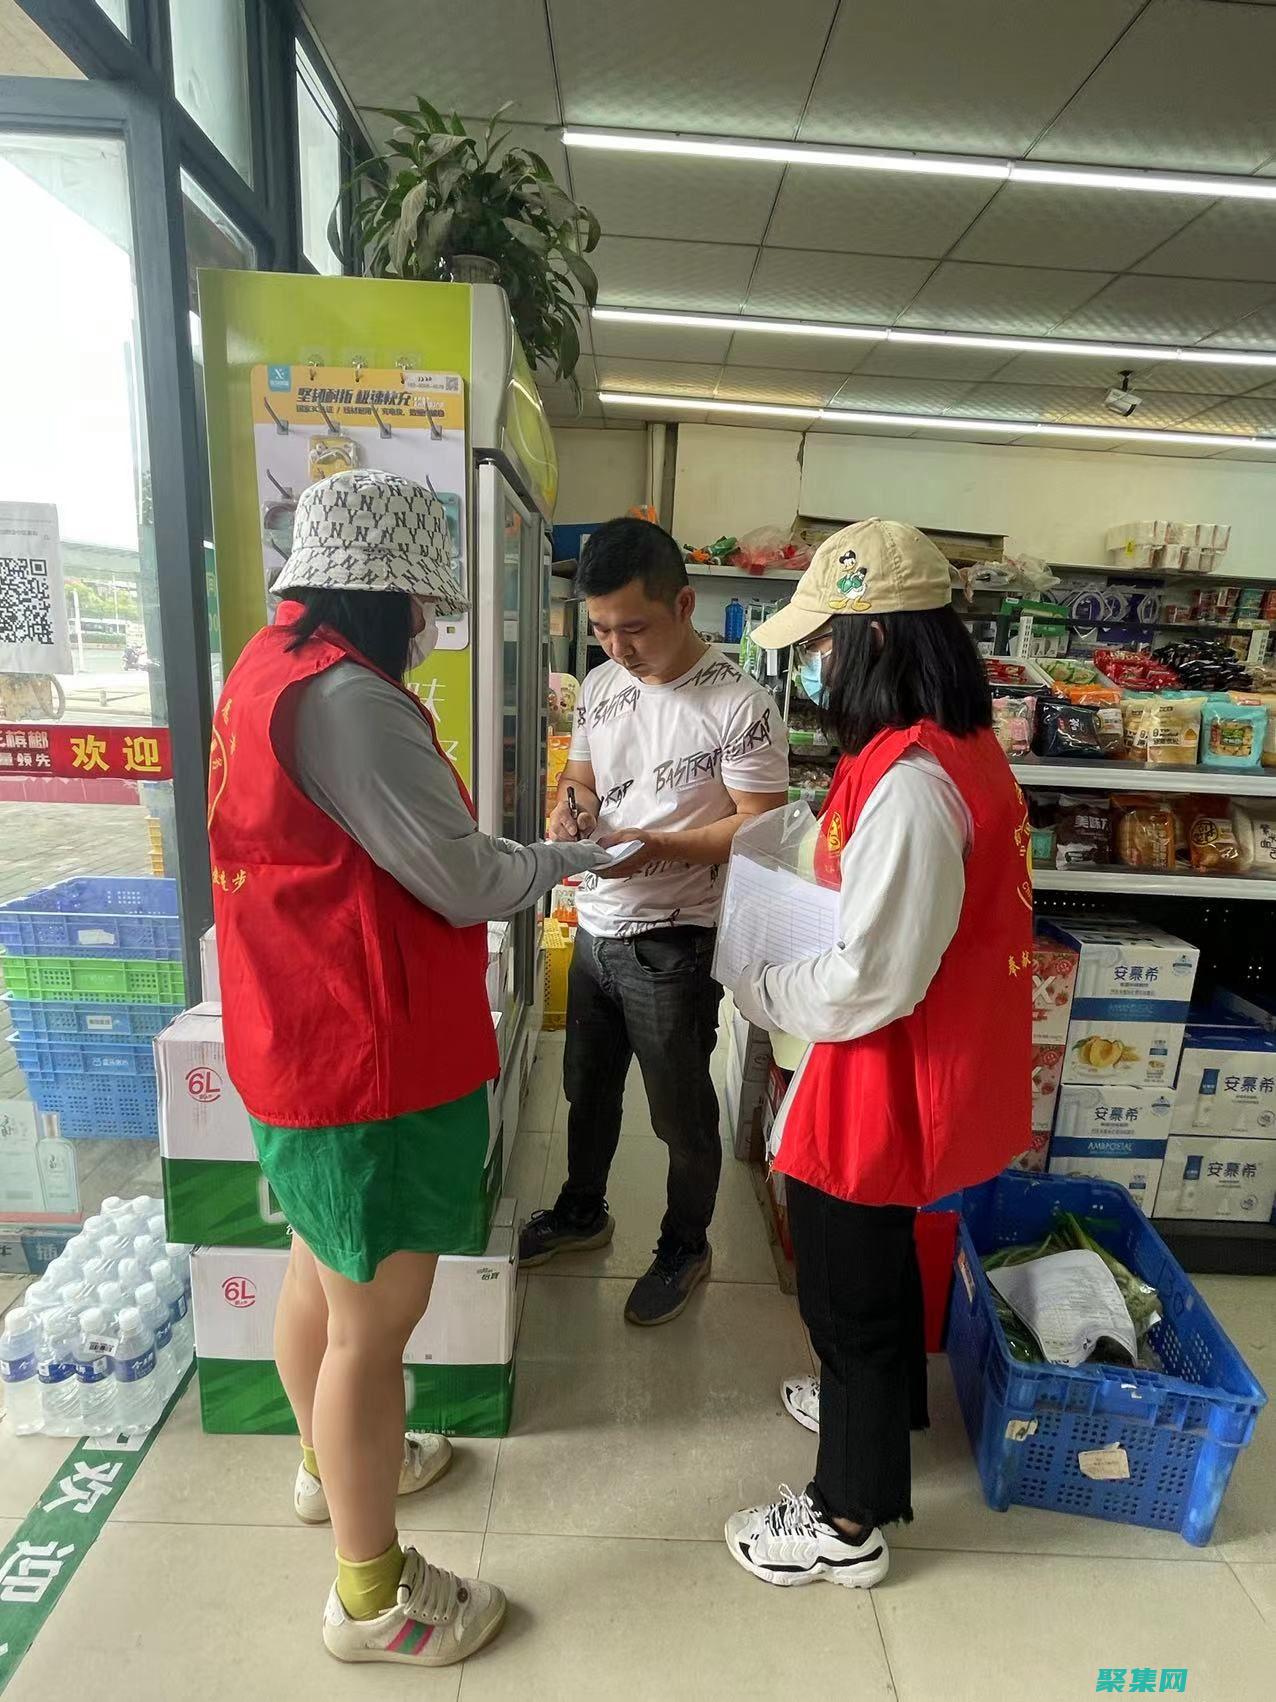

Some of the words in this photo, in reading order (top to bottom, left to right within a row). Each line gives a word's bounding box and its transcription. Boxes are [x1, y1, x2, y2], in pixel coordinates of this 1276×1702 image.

[69, 734, 162, 773] 欢迎
[1114, 965, 1158, 982] 安慕希
[188, 1071, 221, 1095] 6L
[1223, 1075, 1275, 1094] 安慕希
[1094, 1106, 1138, 1122] 安慕希
[1207, 1162, 1257, 1180] 安慕希
[224, 1281, 256, 1302] 6L
